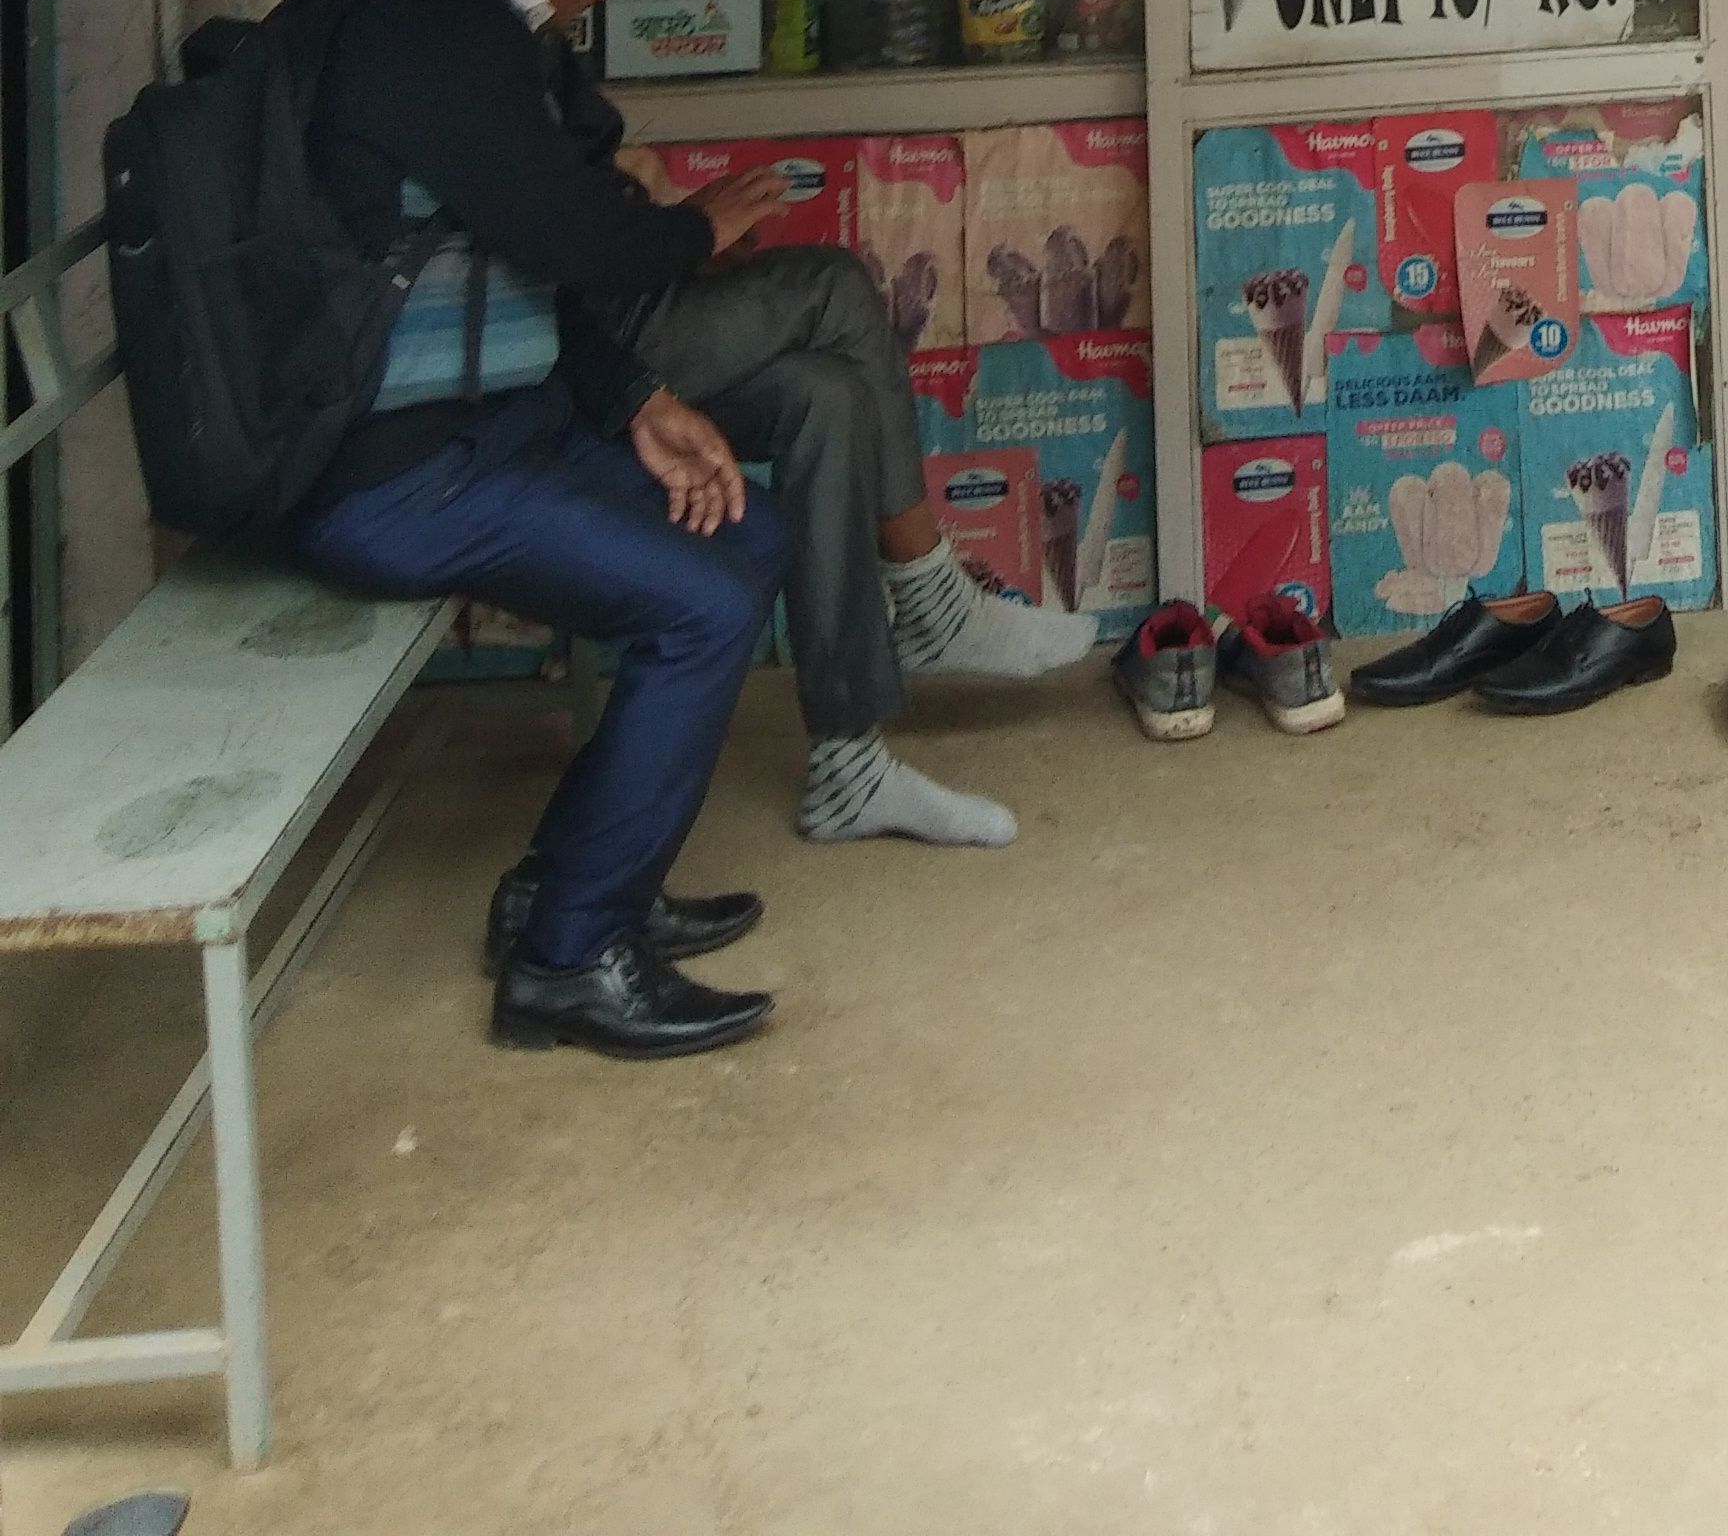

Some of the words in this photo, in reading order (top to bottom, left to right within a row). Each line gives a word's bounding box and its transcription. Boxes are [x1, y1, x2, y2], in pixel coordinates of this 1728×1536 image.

[1307, 130, 1376, 152] Havmo
[1206, 202, 1336, 230] GOODNESS
[1625, 315, 1688, 338] Havmo
[1528, 389, 1656, 416] GOODNESS
